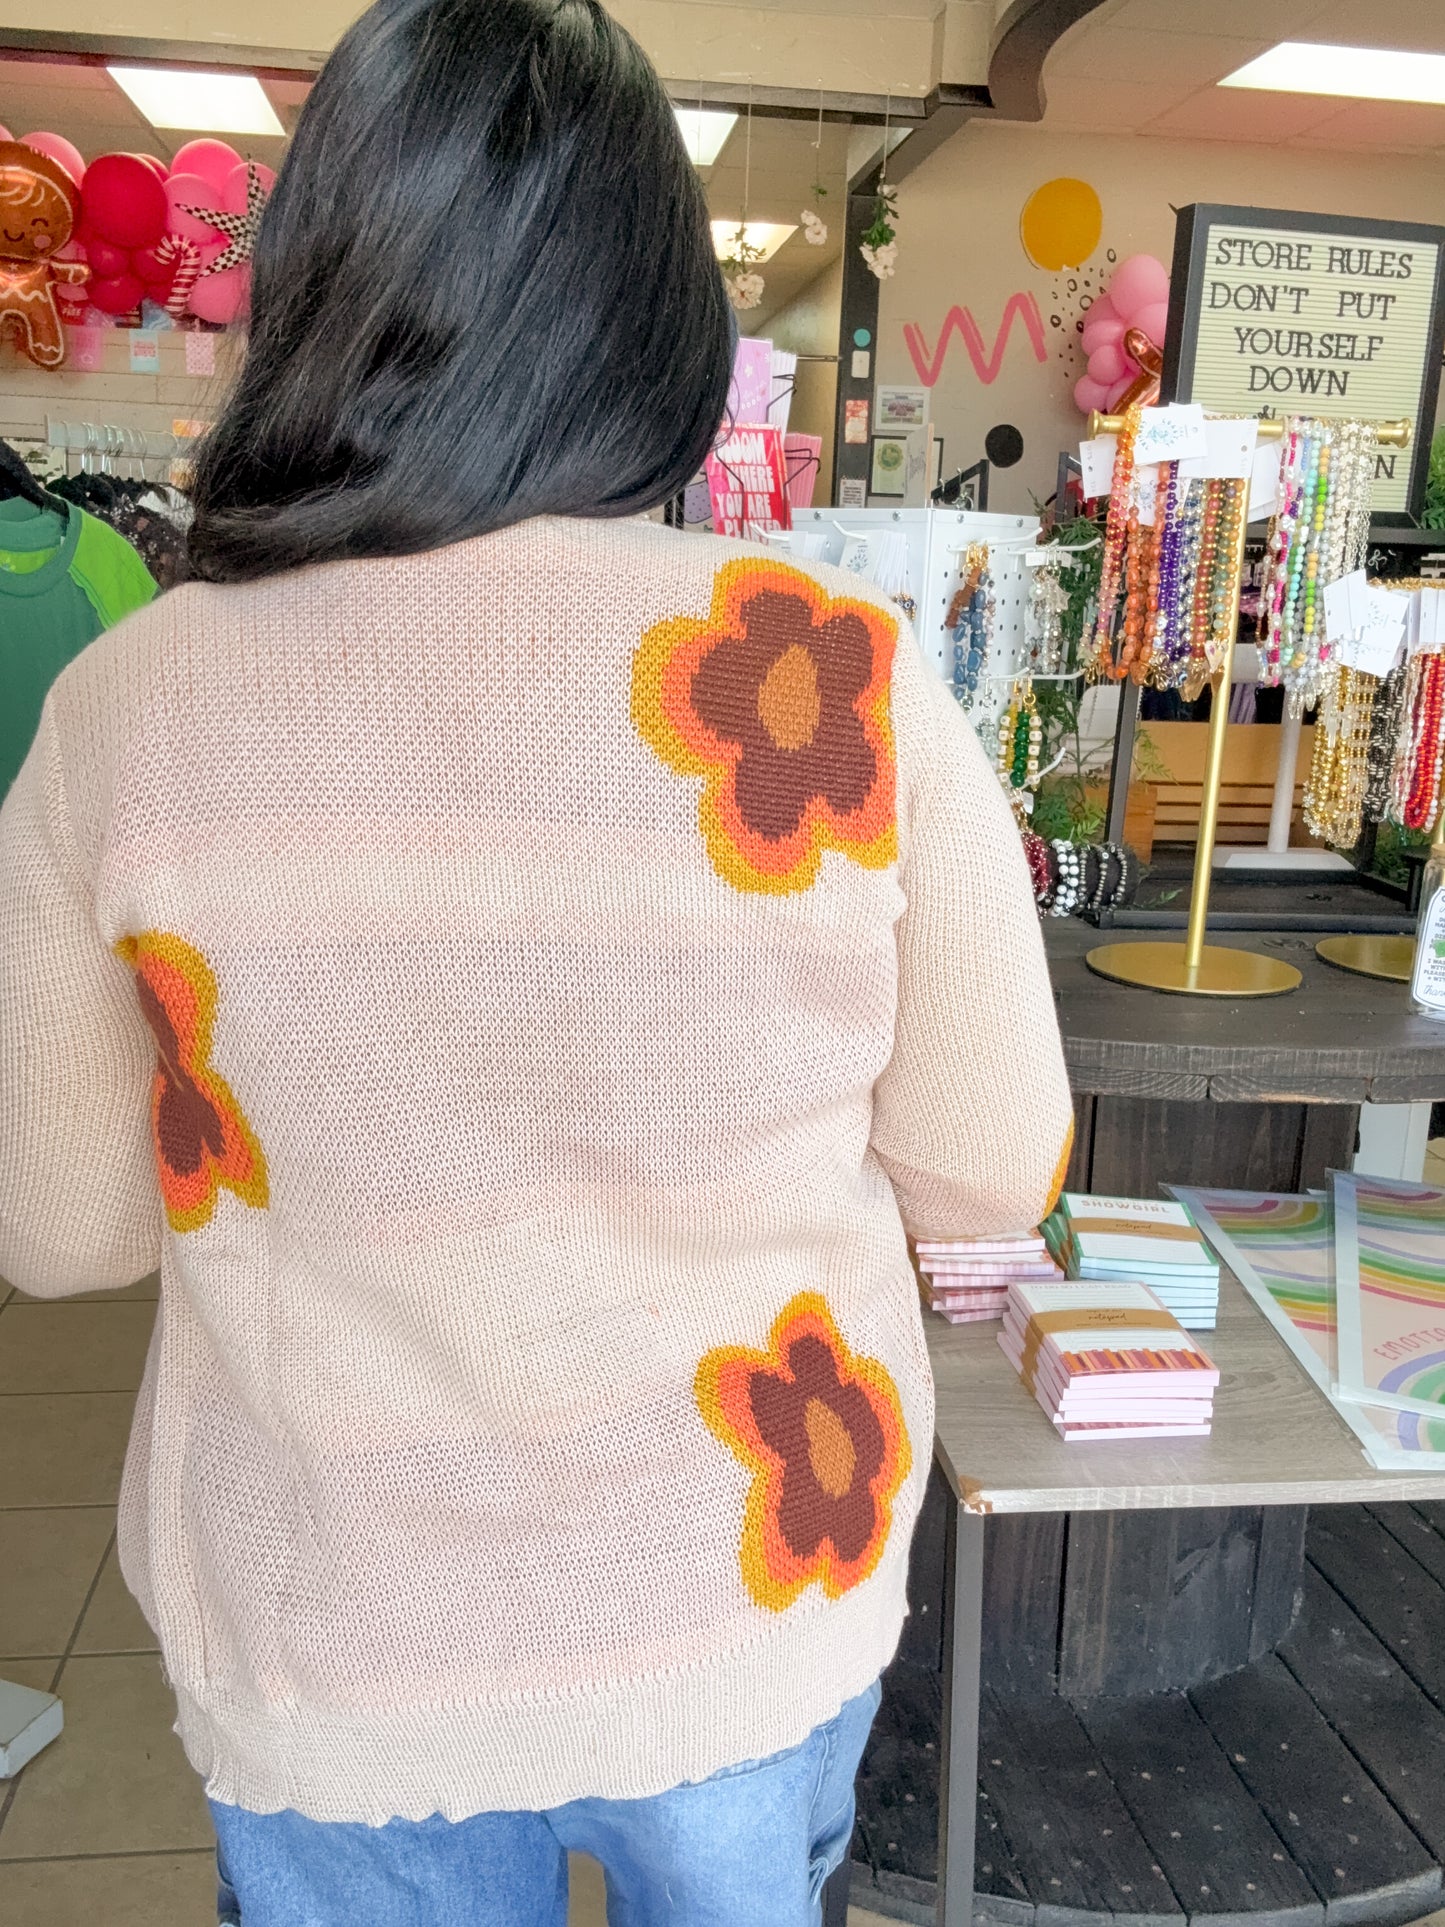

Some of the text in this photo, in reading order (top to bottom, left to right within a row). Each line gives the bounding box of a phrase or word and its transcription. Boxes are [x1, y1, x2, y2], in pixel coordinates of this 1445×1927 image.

[1215, 238, 1413, 279] STORE RULES
[1208, 281, 1396, 321] DON'T PUT
[1234, 327, 1383, 361] YOURSELF
[1248, 366, 1350, 396] DOWN
[727, 465, 775, 493] WHERE
[716, 493, 772, 518] YOU ARE
[1081, 1199, 1171, 1214] SHOWGIRL
[1088, 1312, 1128, 1322] notepad
